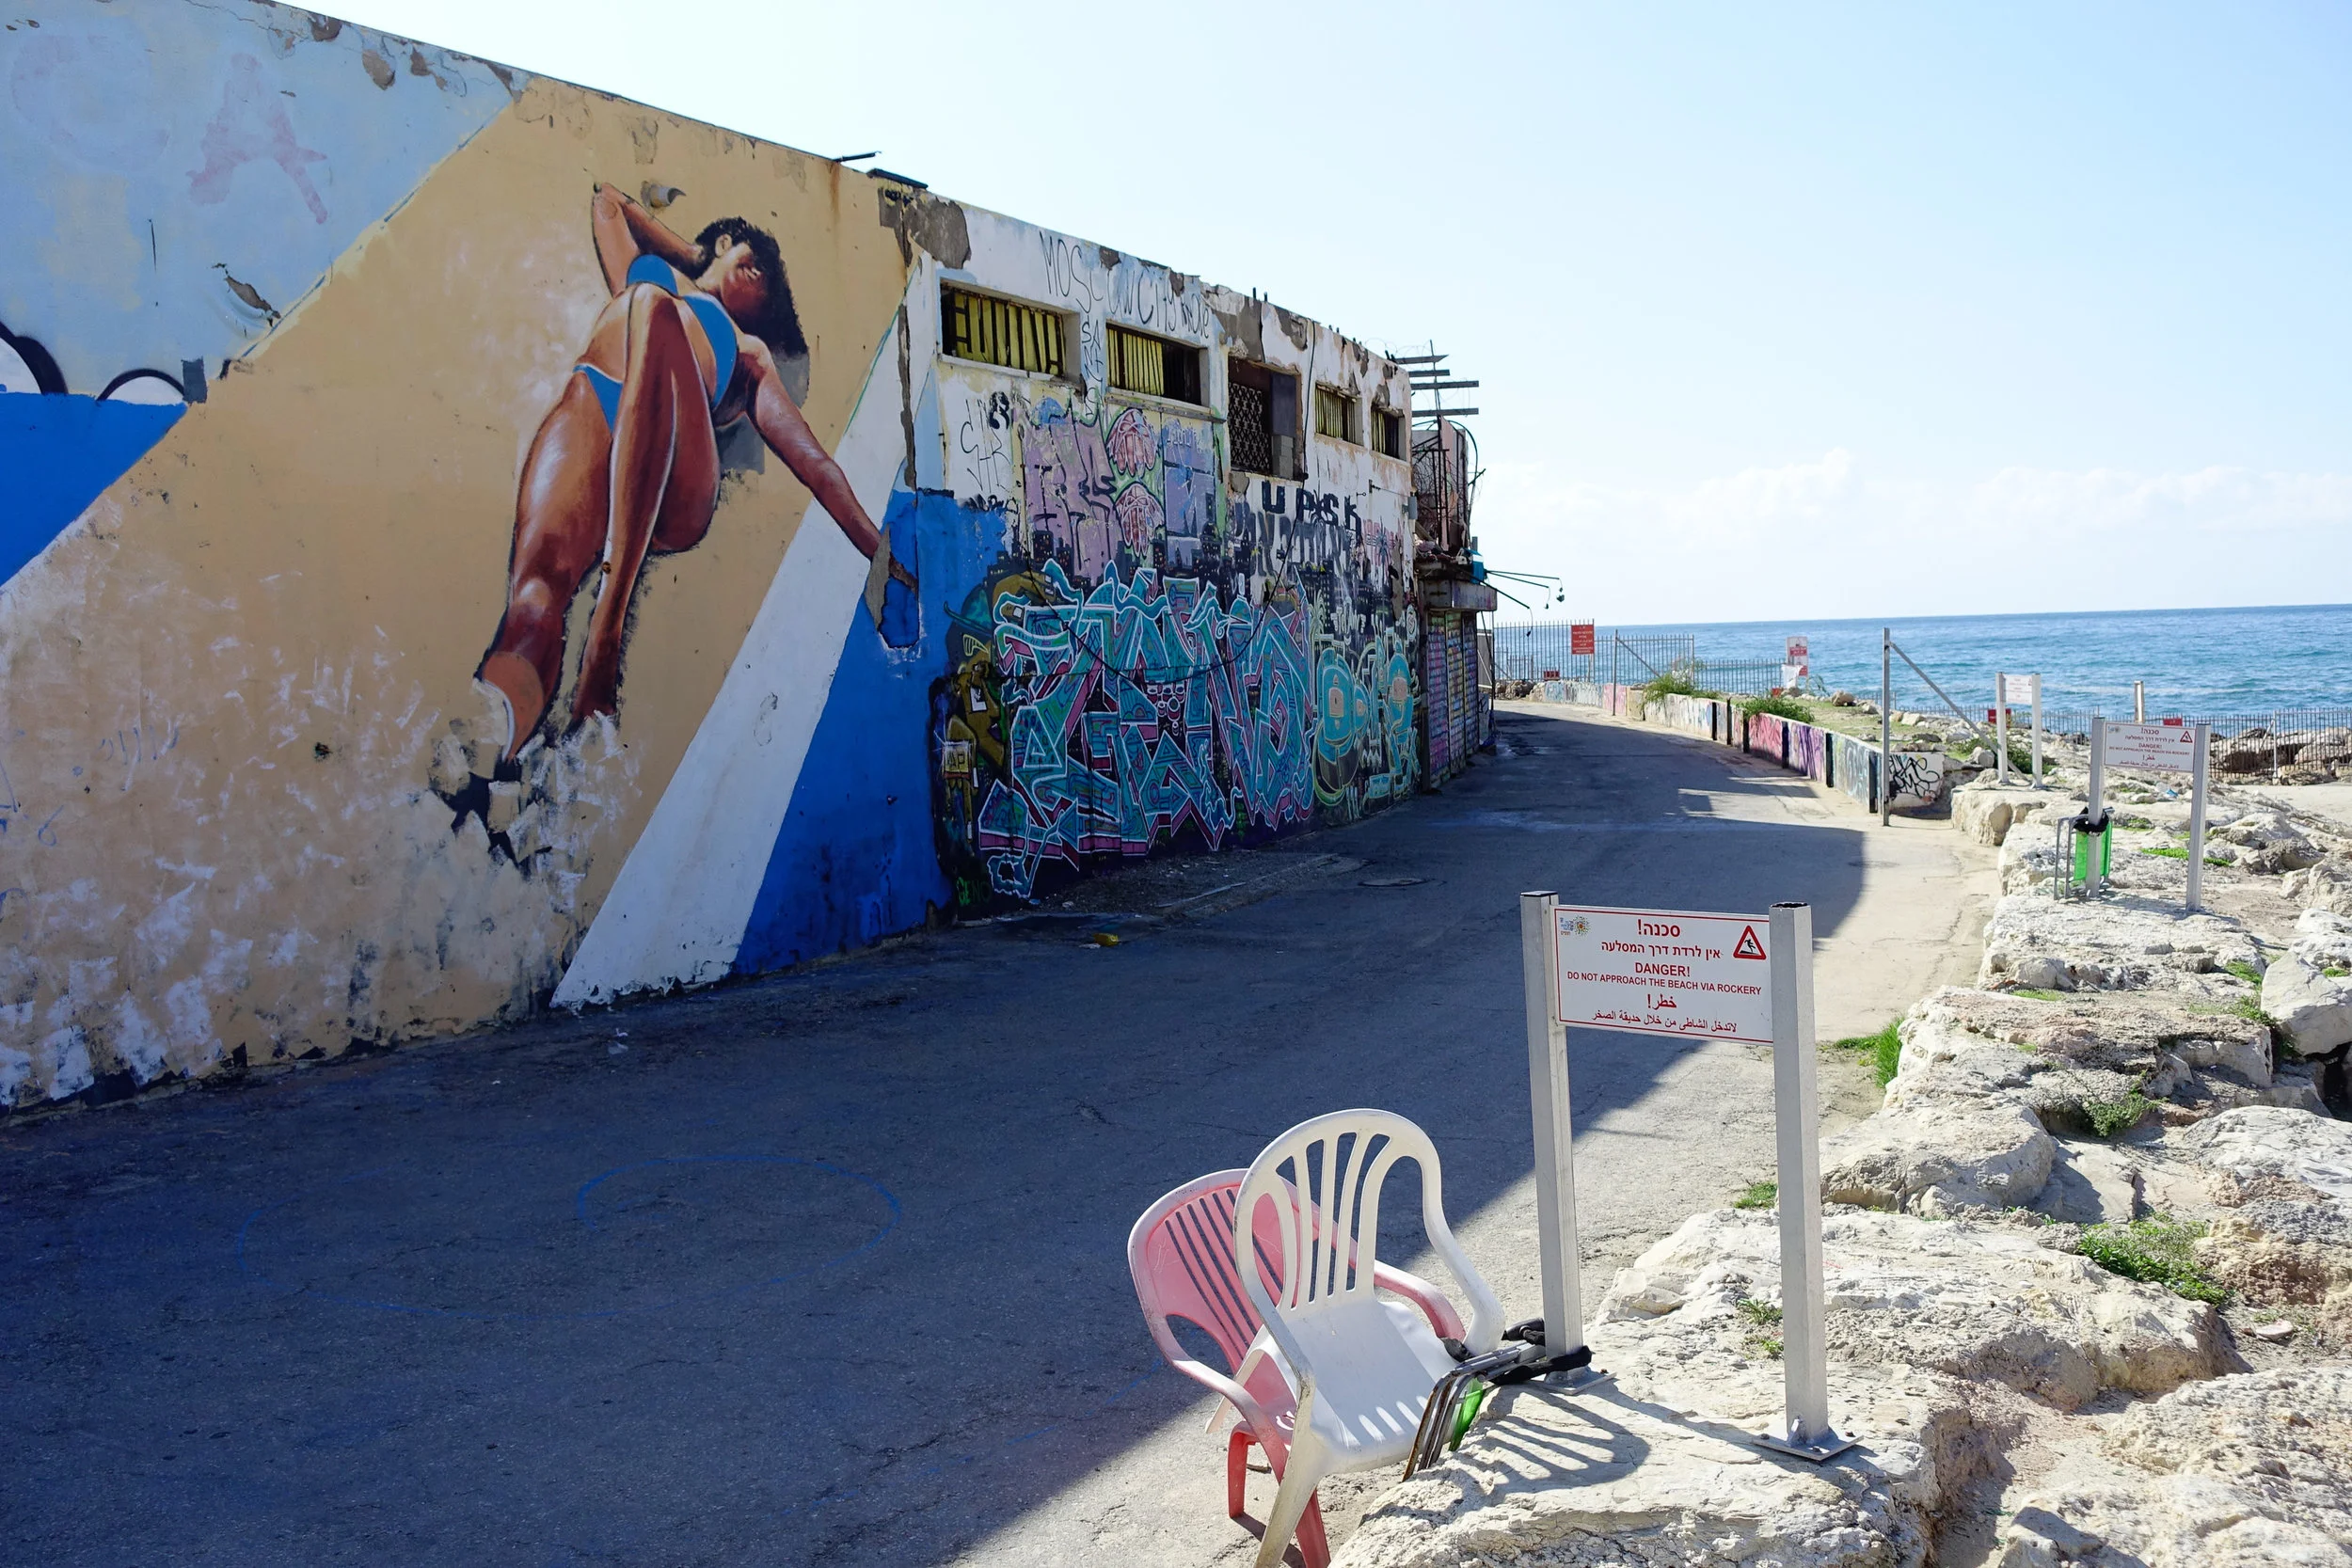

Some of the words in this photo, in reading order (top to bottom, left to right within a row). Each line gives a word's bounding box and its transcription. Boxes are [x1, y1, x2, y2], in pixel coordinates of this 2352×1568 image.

[1638, 919, 1680, 938] סכנה!
[1601, 940, 1645, 954] המסלעה
[1648, 944, 1669, 958] דרך
[1673, 944, 1702, 958] לרדת
[1706, 948, 1721, 960] אין
[1635, 962, 1691, 977] DANGER!
[1567, 971, 1580, 980] DO
[1581, 973, 1598, 981] NOT
[1599, 974, 1647, 986] APPROACH
[1648, 977, 1666, 988] THE
[1667, 979, 1698, 990] BEACH
[1700, 982, 1716, 992] VIA
[1717, 984, 1762, 995] ROCKERY
[1644, 1014, 1661, 1025] خلال
[1664, 1018, 1677, 1028] من
